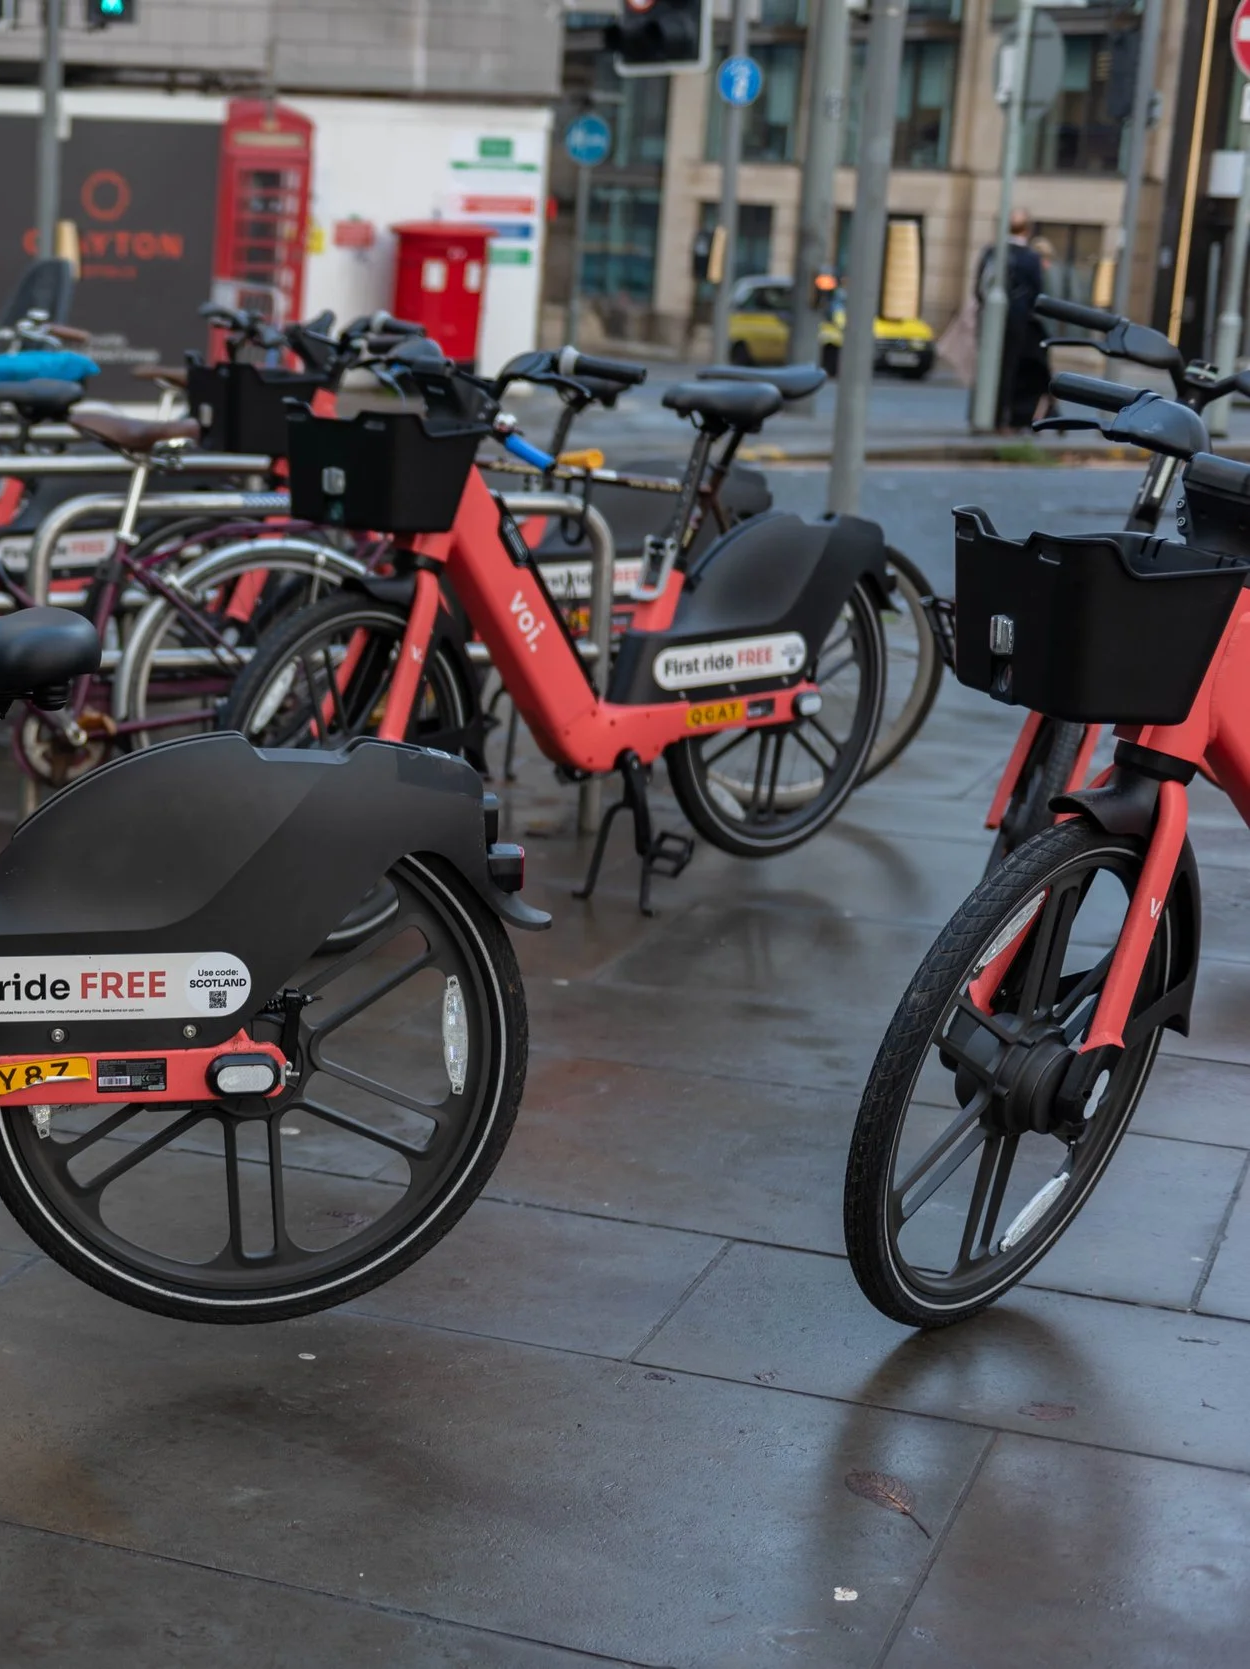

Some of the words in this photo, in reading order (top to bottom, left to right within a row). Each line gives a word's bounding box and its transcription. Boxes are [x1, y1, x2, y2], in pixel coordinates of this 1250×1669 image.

[510, 591, 545, 653] voi.
[664, 659, 700, 677] First
[704, 654, 734, 671] ride
[737, 646, 773, 667] FREE
[81, 971, 166, 999] FREE
[189, 978, 247, 988] SCOTLAND
[197, 969, 214, 977] Use
